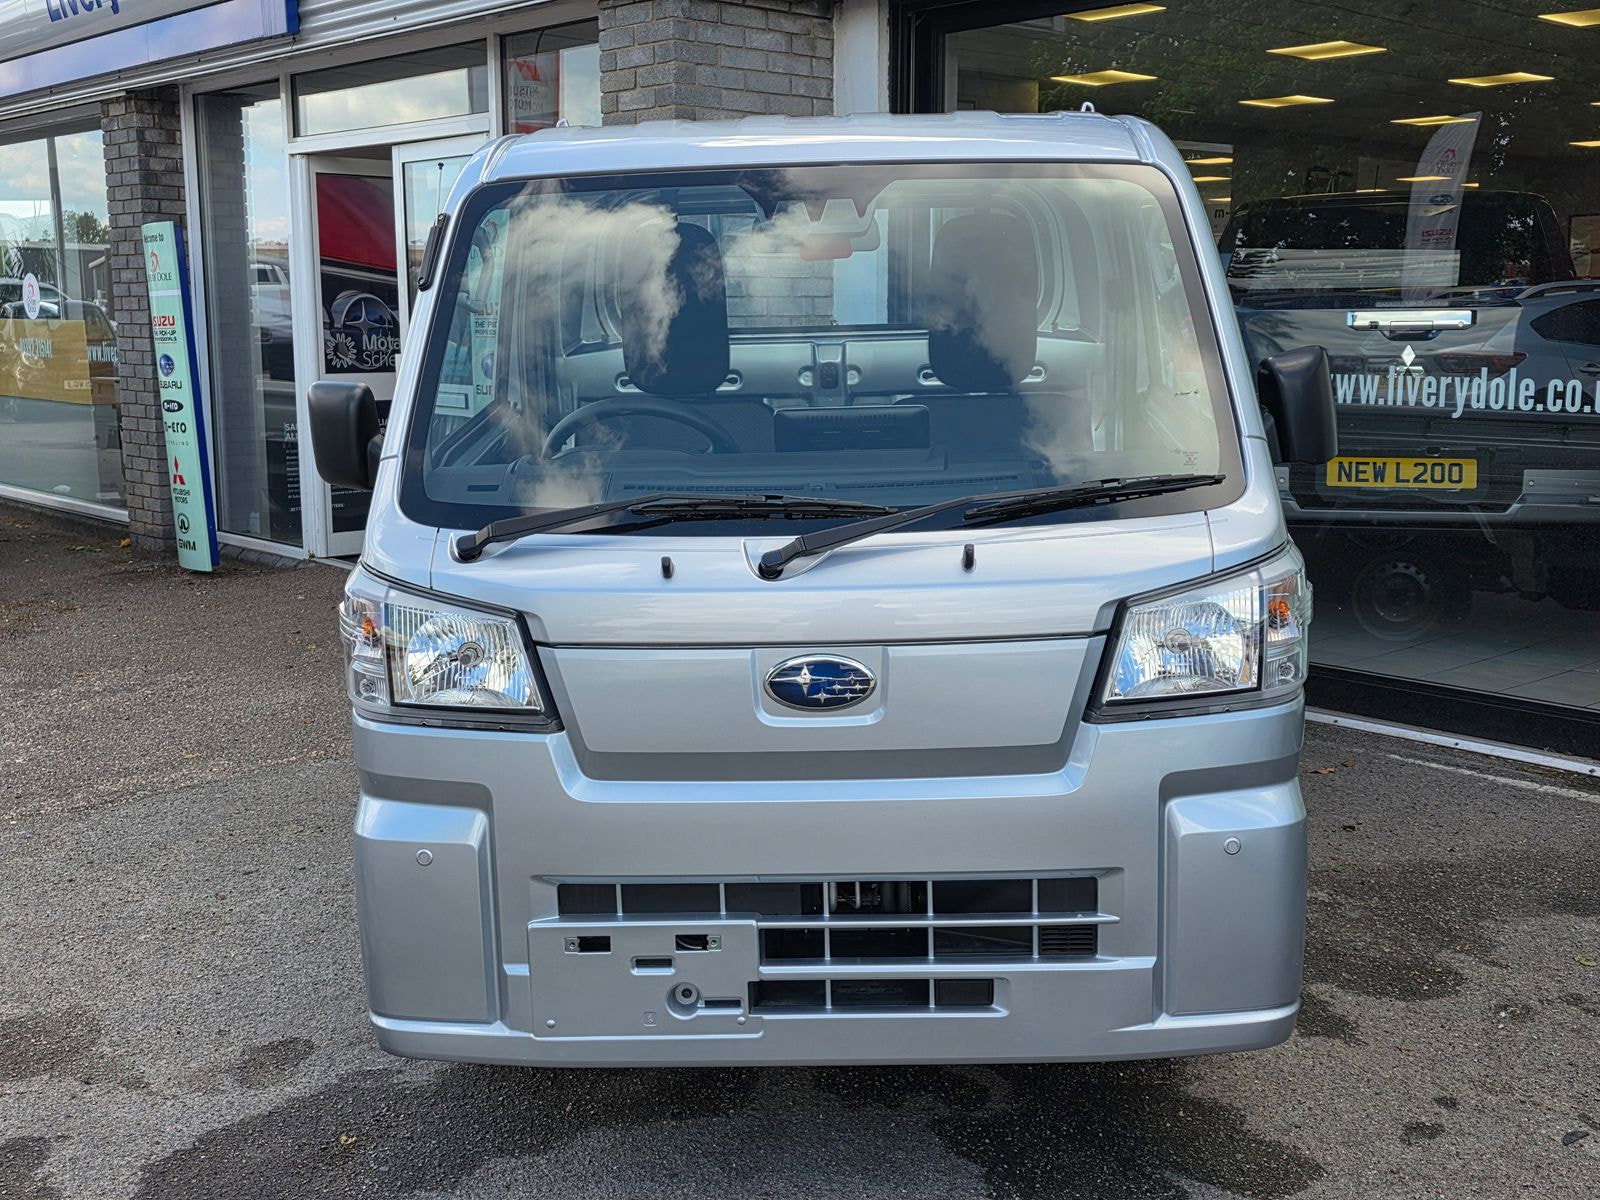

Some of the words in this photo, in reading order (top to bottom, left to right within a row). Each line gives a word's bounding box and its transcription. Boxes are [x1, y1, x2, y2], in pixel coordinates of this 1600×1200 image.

[157, 272, 172, 281] DOLE
[153, 316, 175, 327] SUZU
[1331, 367, 1600, 419] ww.liverydole.co.
[1337, 461, 1387, 484] NEW
[1395, 462, 1464, 485] L200
[178, 538, 197, 551] GWM
